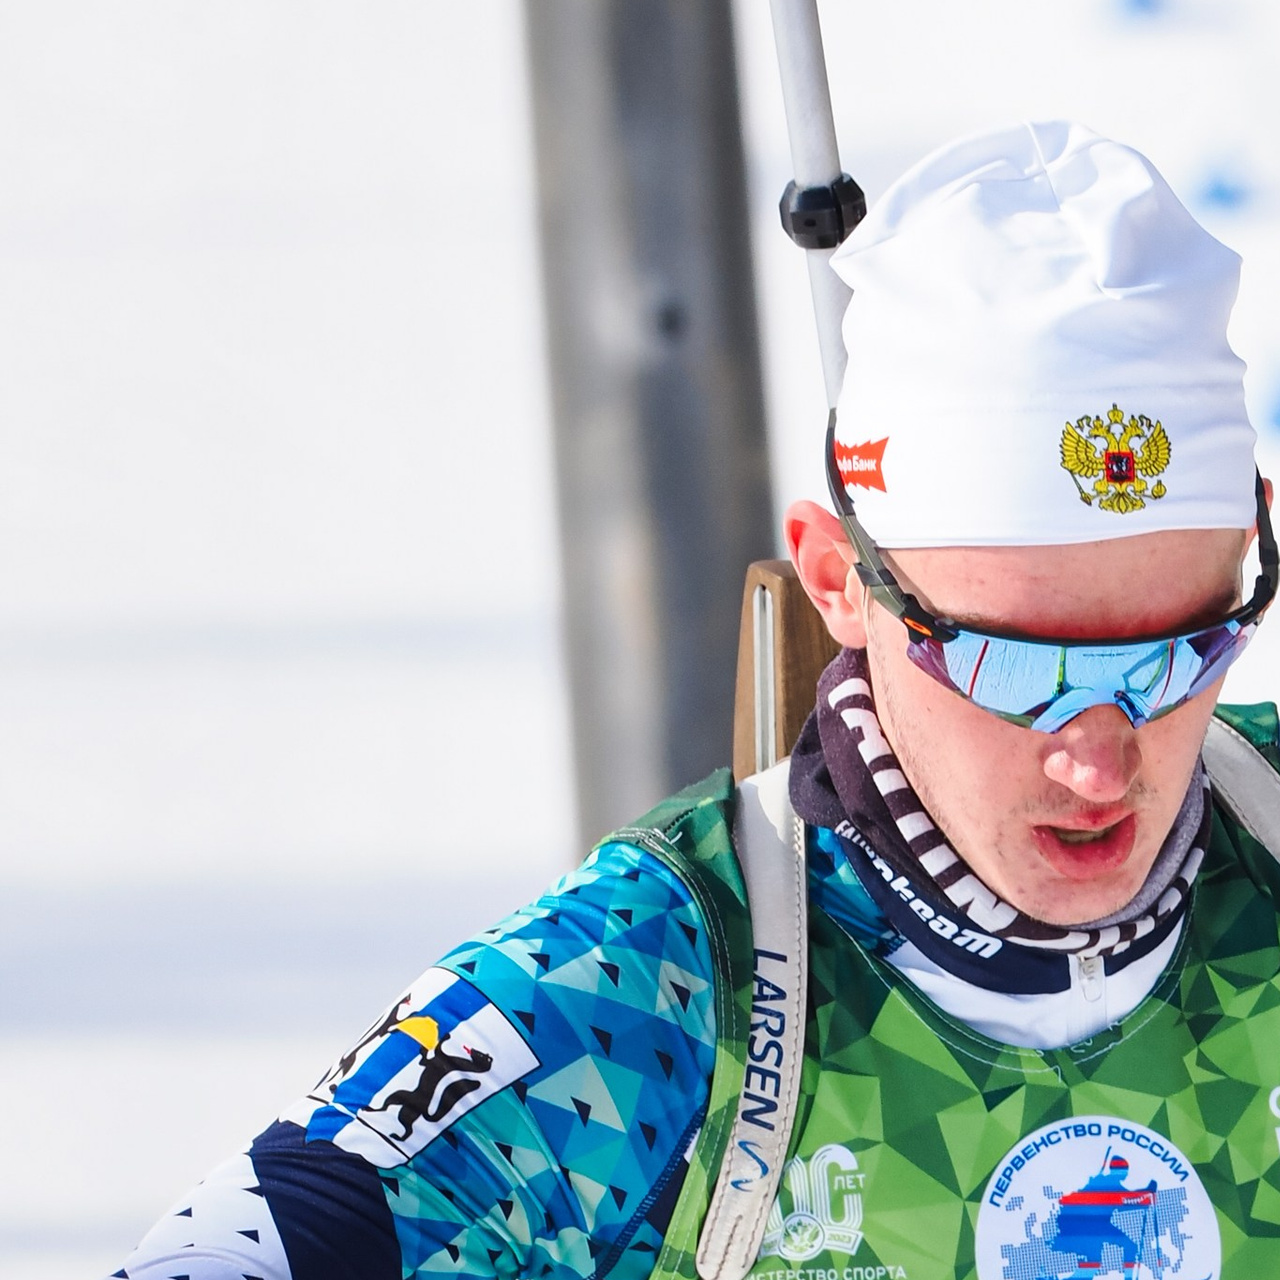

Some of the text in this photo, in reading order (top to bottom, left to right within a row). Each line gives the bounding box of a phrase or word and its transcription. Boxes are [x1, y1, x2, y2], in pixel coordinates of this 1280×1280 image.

[741, 948, 788, 1132] LARSEN
[834, 1174, 866, 1190] ЛЕТ
[989, 1123, 1190, 1208] ПЕРВЕНСТВО РОССИИ
